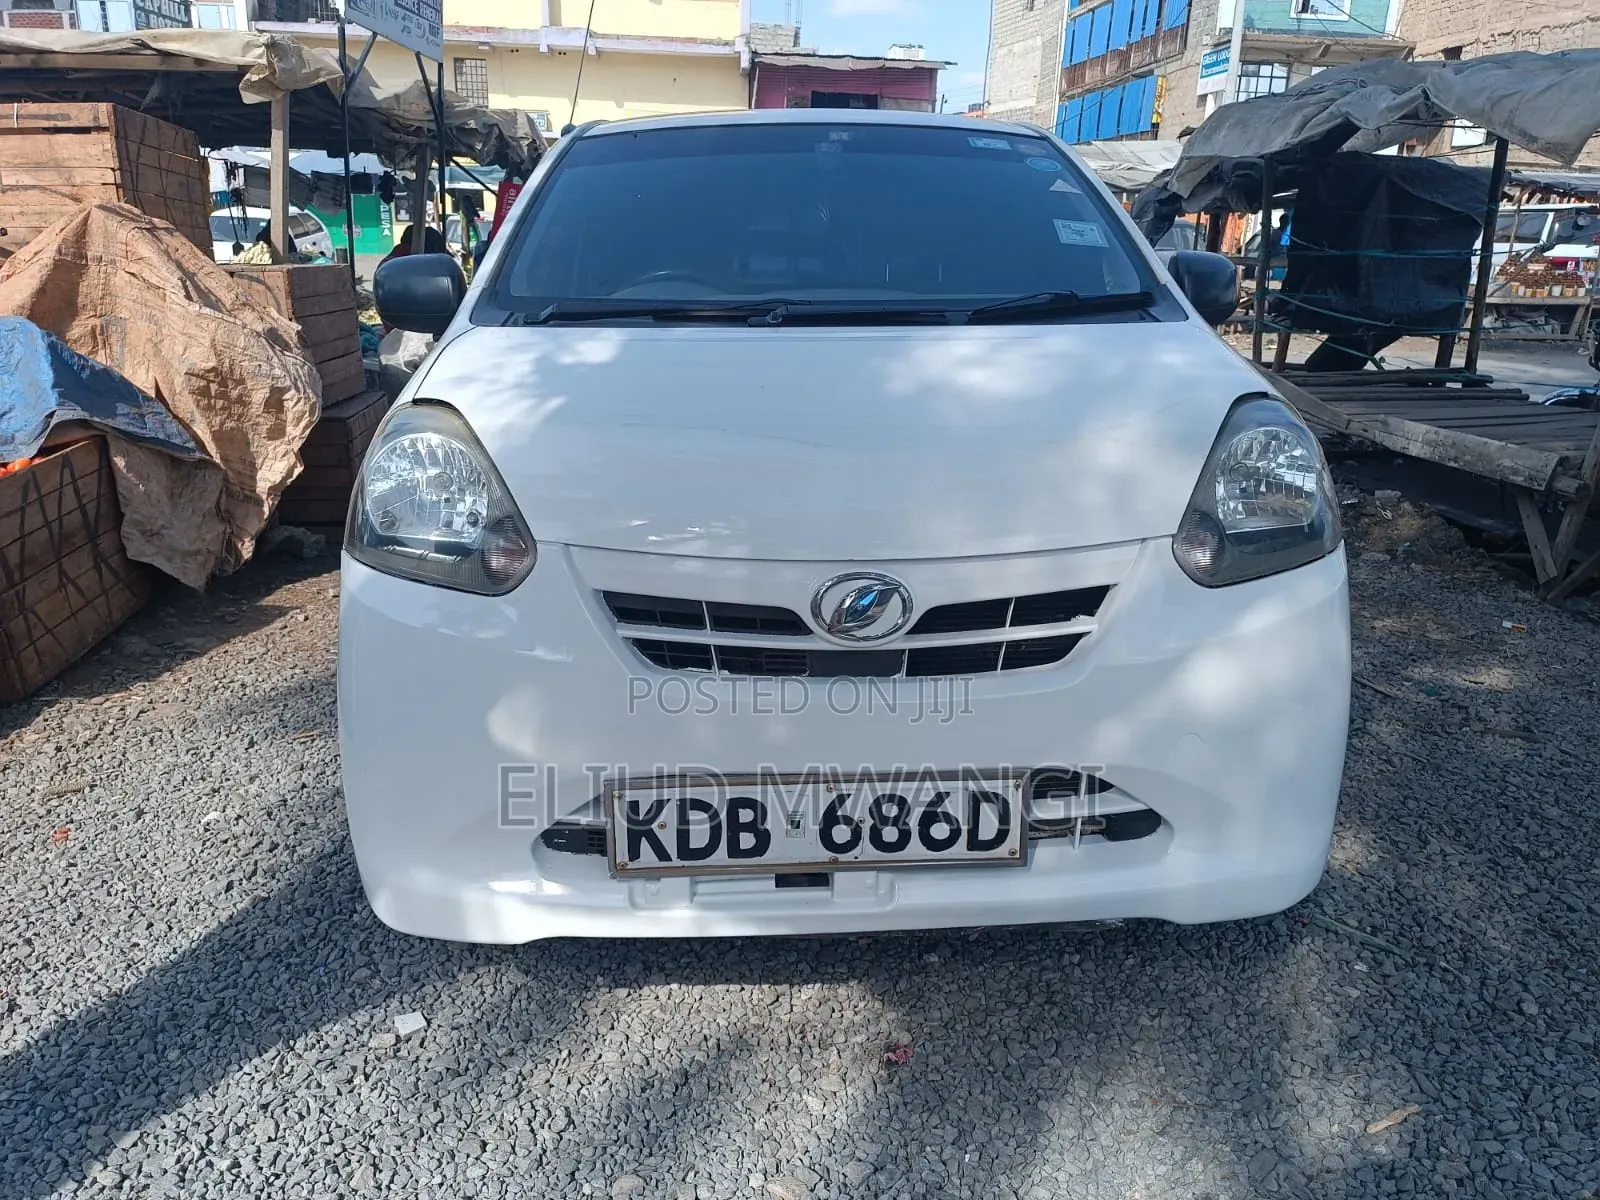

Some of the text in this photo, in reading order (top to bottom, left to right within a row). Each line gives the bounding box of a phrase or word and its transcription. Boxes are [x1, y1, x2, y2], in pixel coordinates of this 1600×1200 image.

[148, 14, 182, 29] HOTE
[1217, 49, 1231, 60] LODG
[625, 791, 1012, 862] KDB 686D
